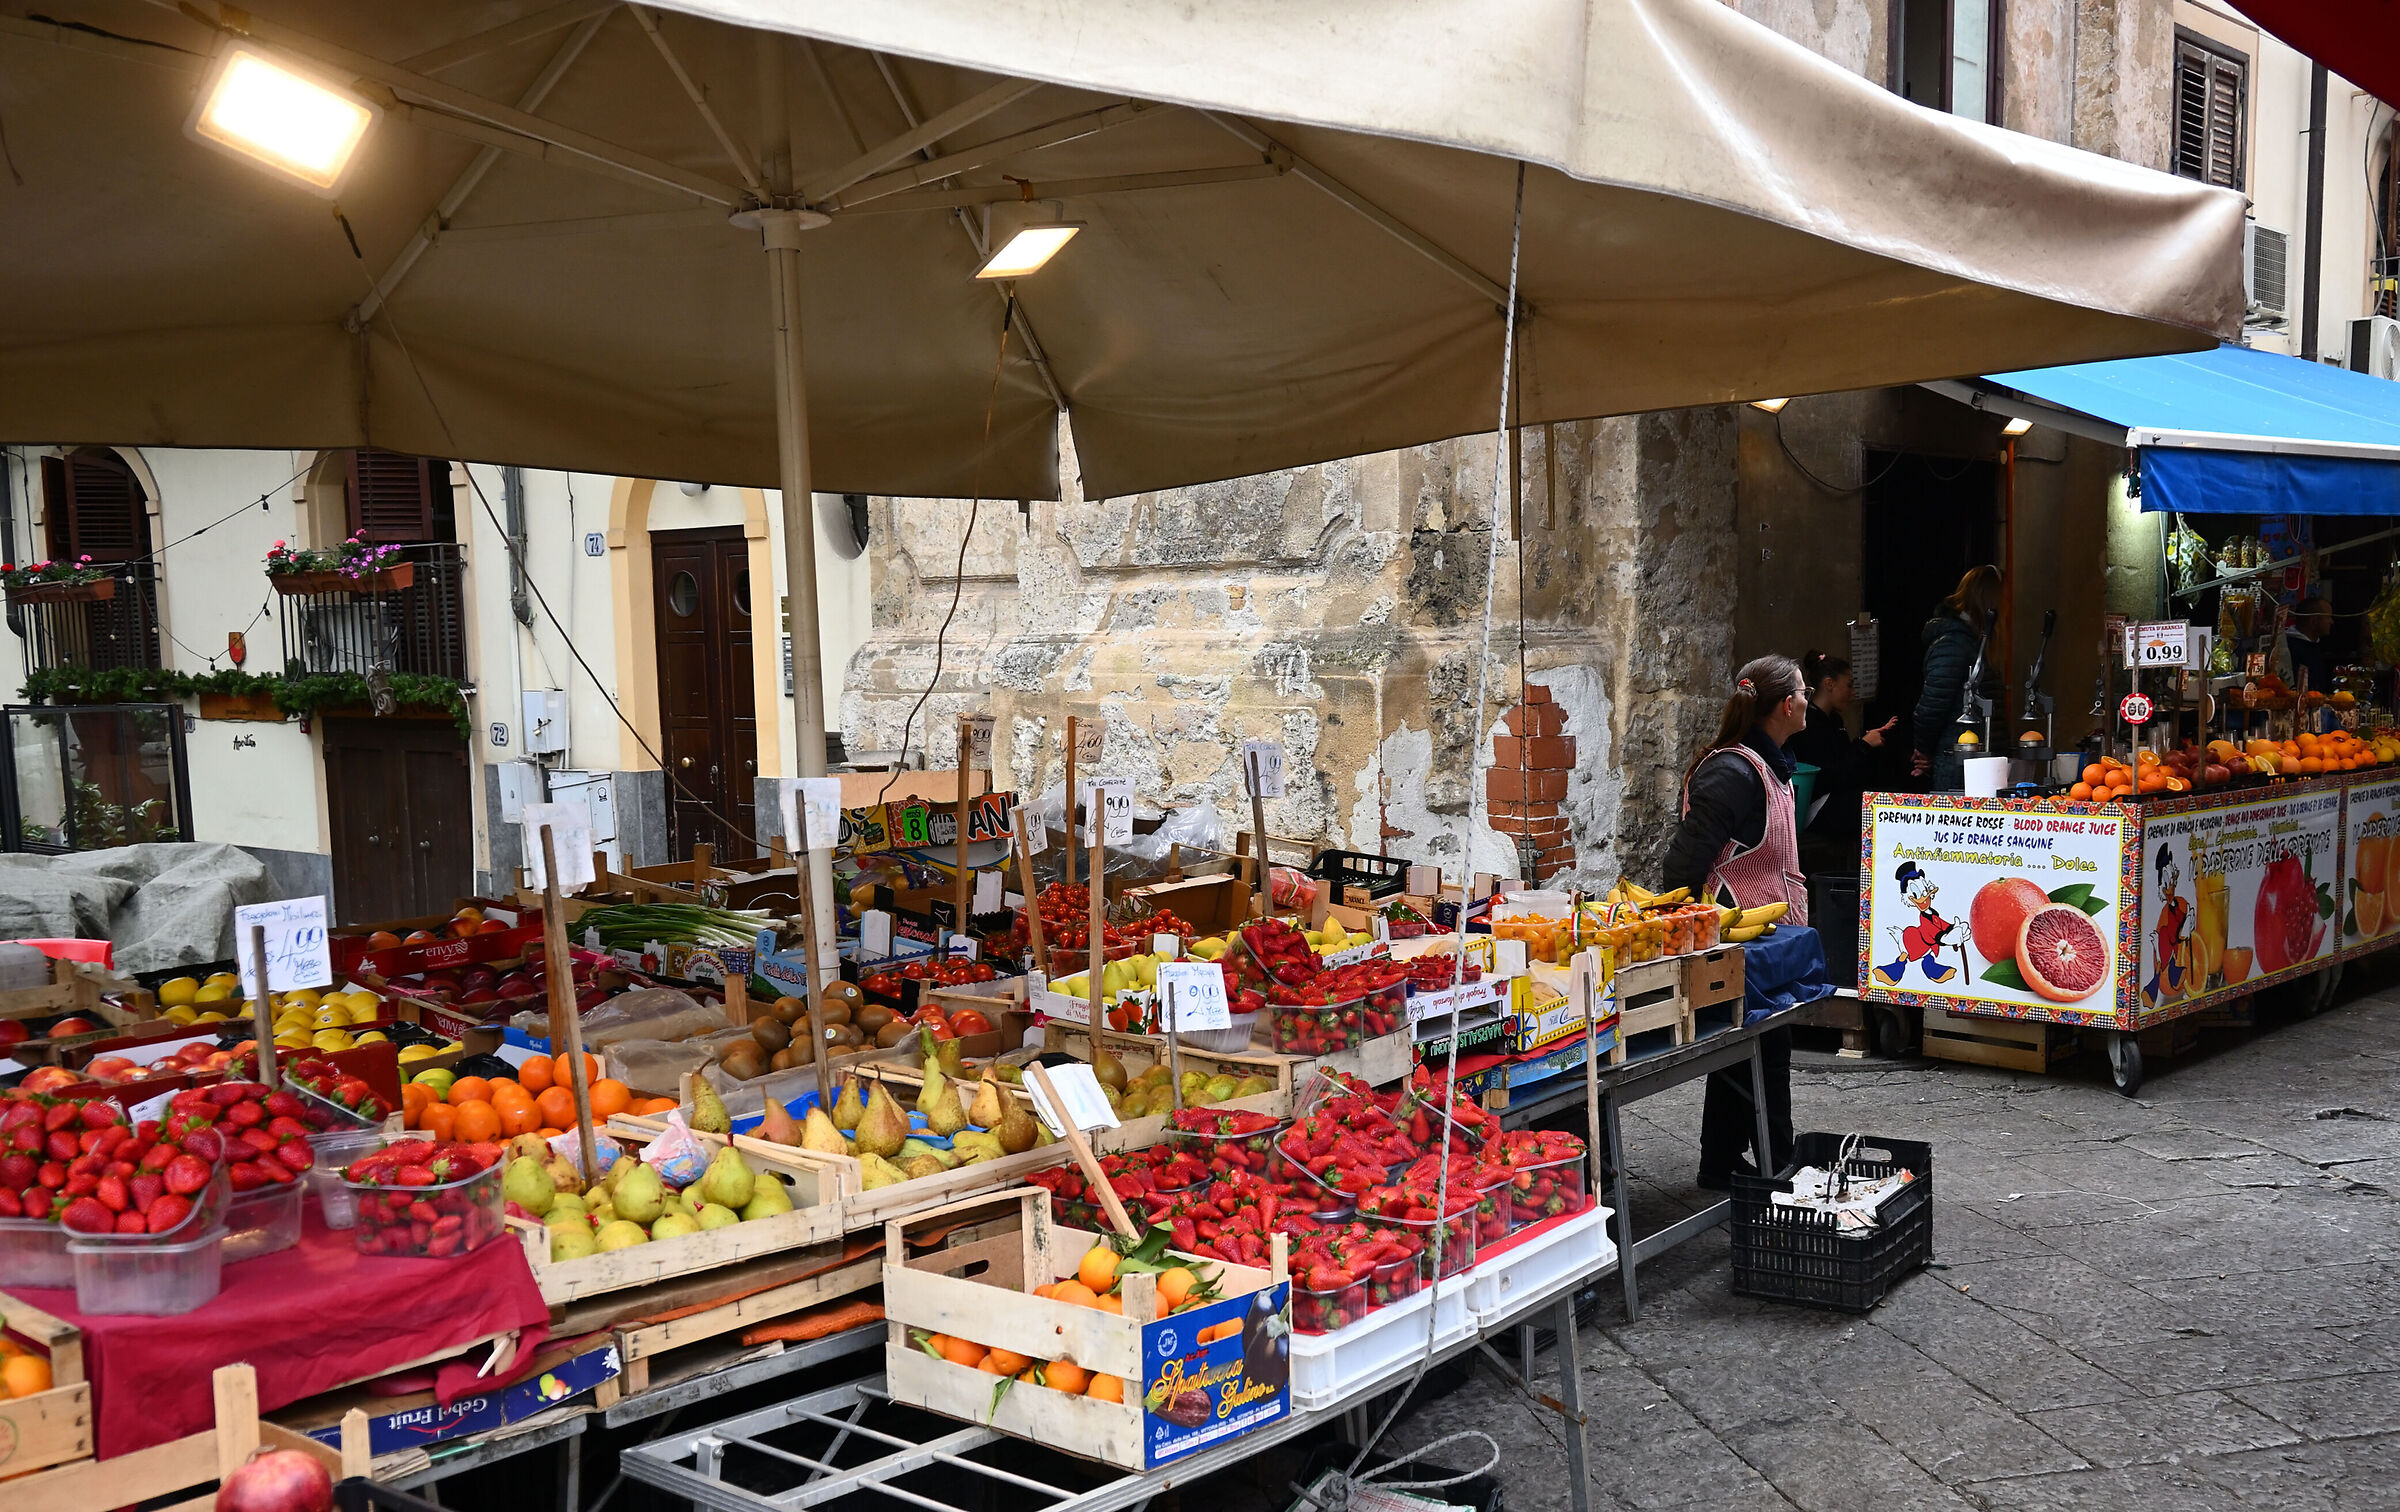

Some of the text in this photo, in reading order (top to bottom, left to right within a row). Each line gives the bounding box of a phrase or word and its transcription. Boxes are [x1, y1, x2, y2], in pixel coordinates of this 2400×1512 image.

[589, 537, 600, 553] 74
[2146, 645, 2182, 661] 0,99
[494, 726, 505, 742] 72
[1878, 811, 2117, 836] SPREMUTA DI ARANCE ROSSE BLOOD ORANGE JUICE
[1933, 831, 2054, 850] JUS DE ORANGE SANGUINE
[1893, 843, 2023, 867] Antinfiammatoria
[2052, 854, 2098, 872] Dolce
[426, 945, 456, 961] envy
[389, 1408, 433, 1430] Fruit
